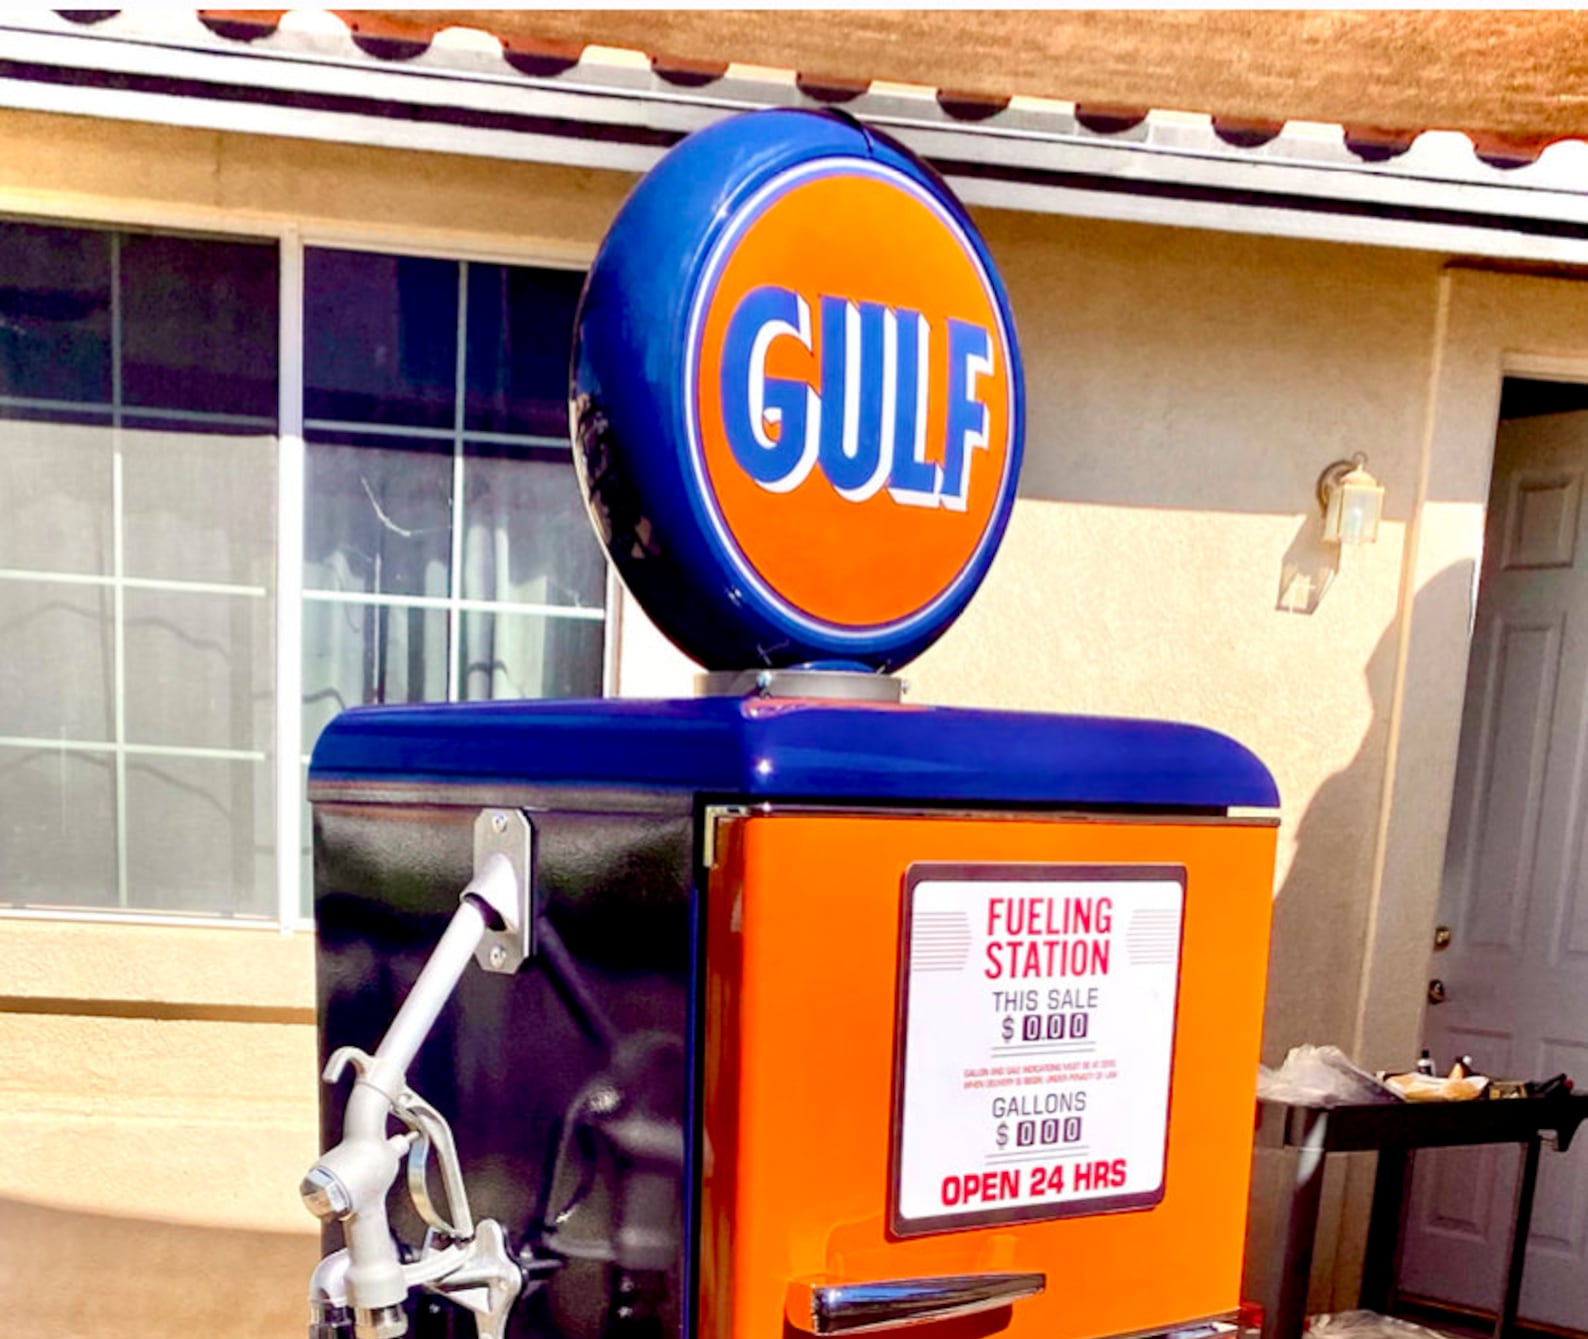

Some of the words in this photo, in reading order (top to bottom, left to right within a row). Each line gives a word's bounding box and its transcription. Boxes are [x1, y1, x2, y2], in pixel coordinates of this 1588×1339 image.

[720, 284, 995, 513] GULF
[986, 896, 1113, 936] FUELING
[984, 938, 1111, 980] STATION
[992, 989, 1039, 1012] THIS
[1047, 987, 1099, 1010] SALE
[992, 1091, 1087, 1119] GALLONS
[940, 1169, 1020, 1207] OPEN
[1029, 1164, 1064, 1197] 24
[1073, 1157, 1127, 1192] HRS
